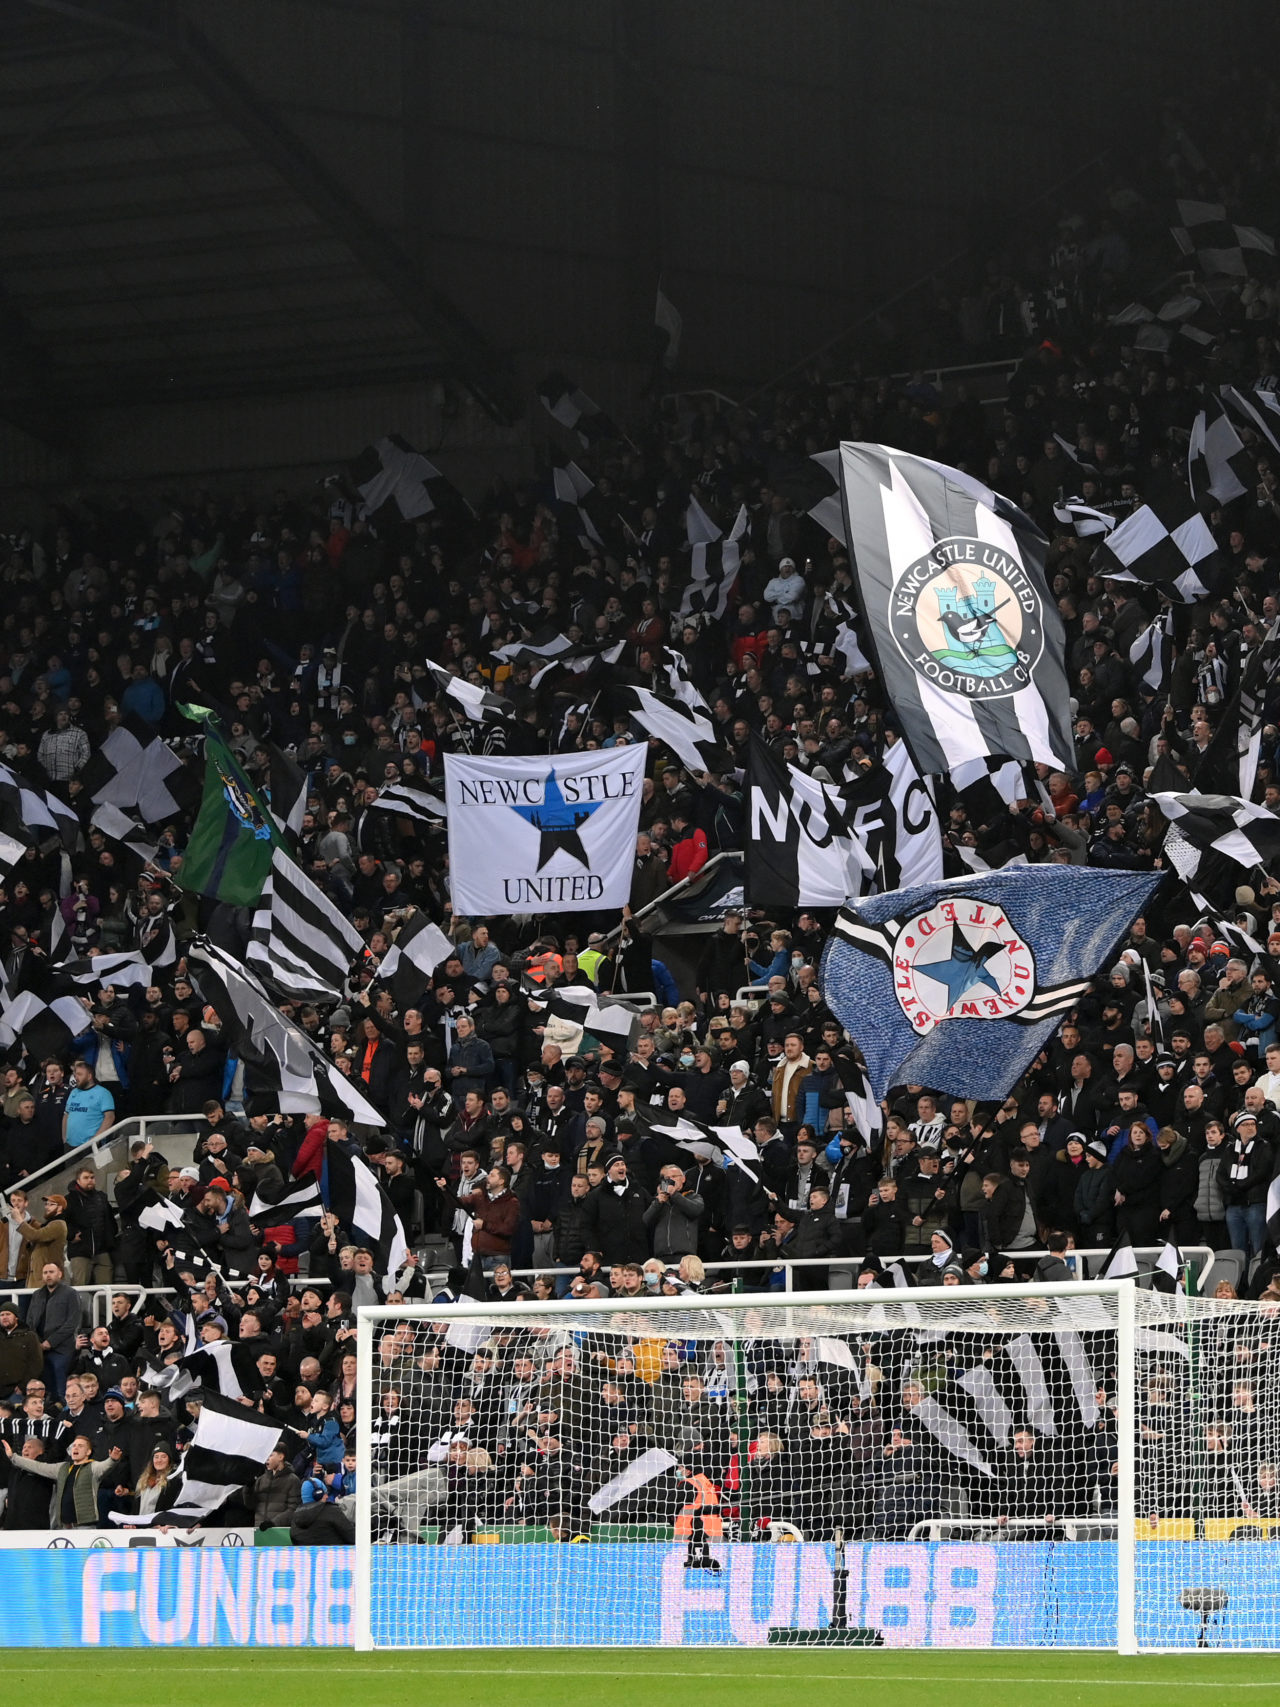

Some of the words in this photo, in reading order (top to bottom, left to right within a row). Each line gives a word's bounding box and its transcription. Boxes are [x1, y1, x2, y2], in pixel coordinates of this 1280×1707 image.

[897, 544, 976, 616] NEWCASTLE
[982, 549, 1035, 613] UNITED
[915, 652, 1013, 693] FOOTBALL
[751, 779, 932, 848] NUFC
[503, 875, 604, 904] UNITED
[895, 955, 1020, 1027] NEWSTLE
[81, 1550, 355, 1644] FUN88
[661, 1544, 998, 1646] FUN88
